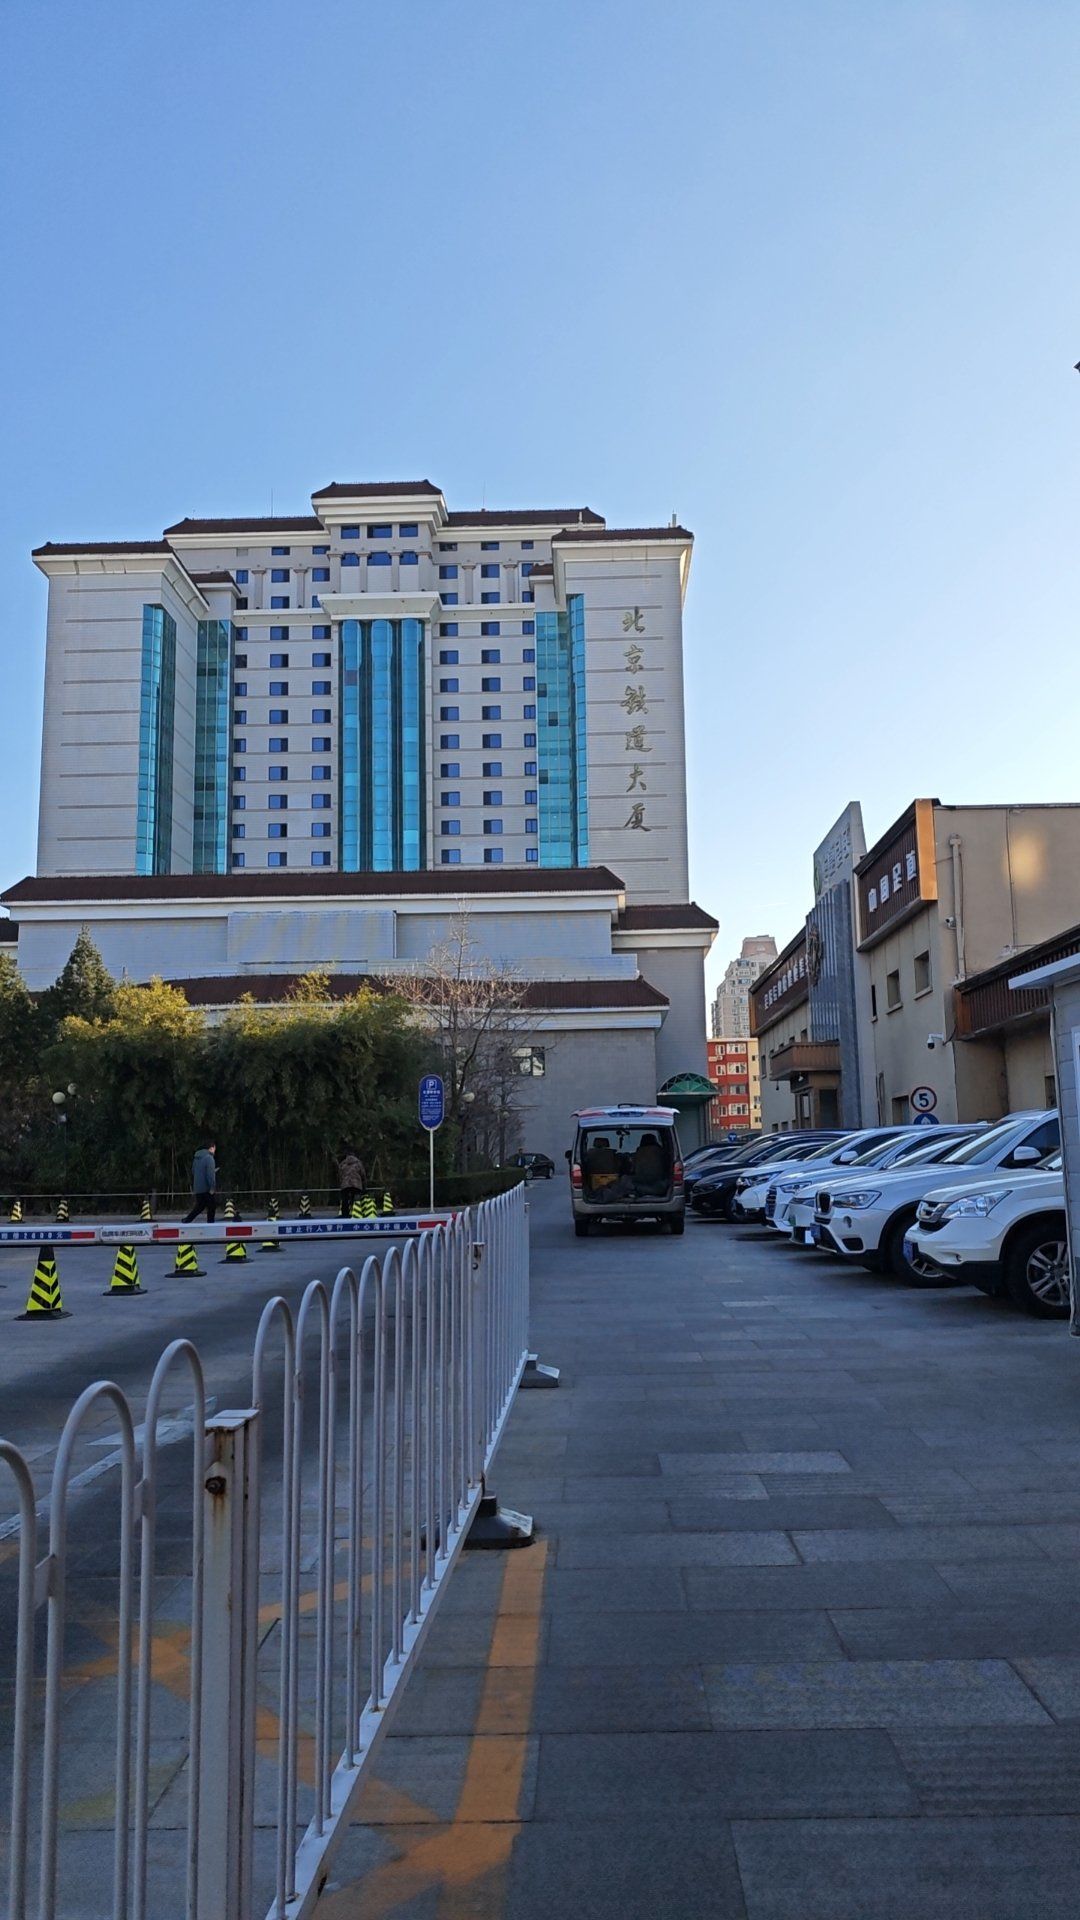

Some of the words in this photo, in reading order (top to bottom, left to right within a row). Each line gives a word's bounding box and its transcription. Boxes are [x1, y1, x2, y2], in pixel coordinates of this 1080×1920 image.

[620, 606, 653, 832] 北京铁道大厦
[919, 1093, 929, 1107] 5
[286, 1225, 343, 1233] 禁止行人穿行
